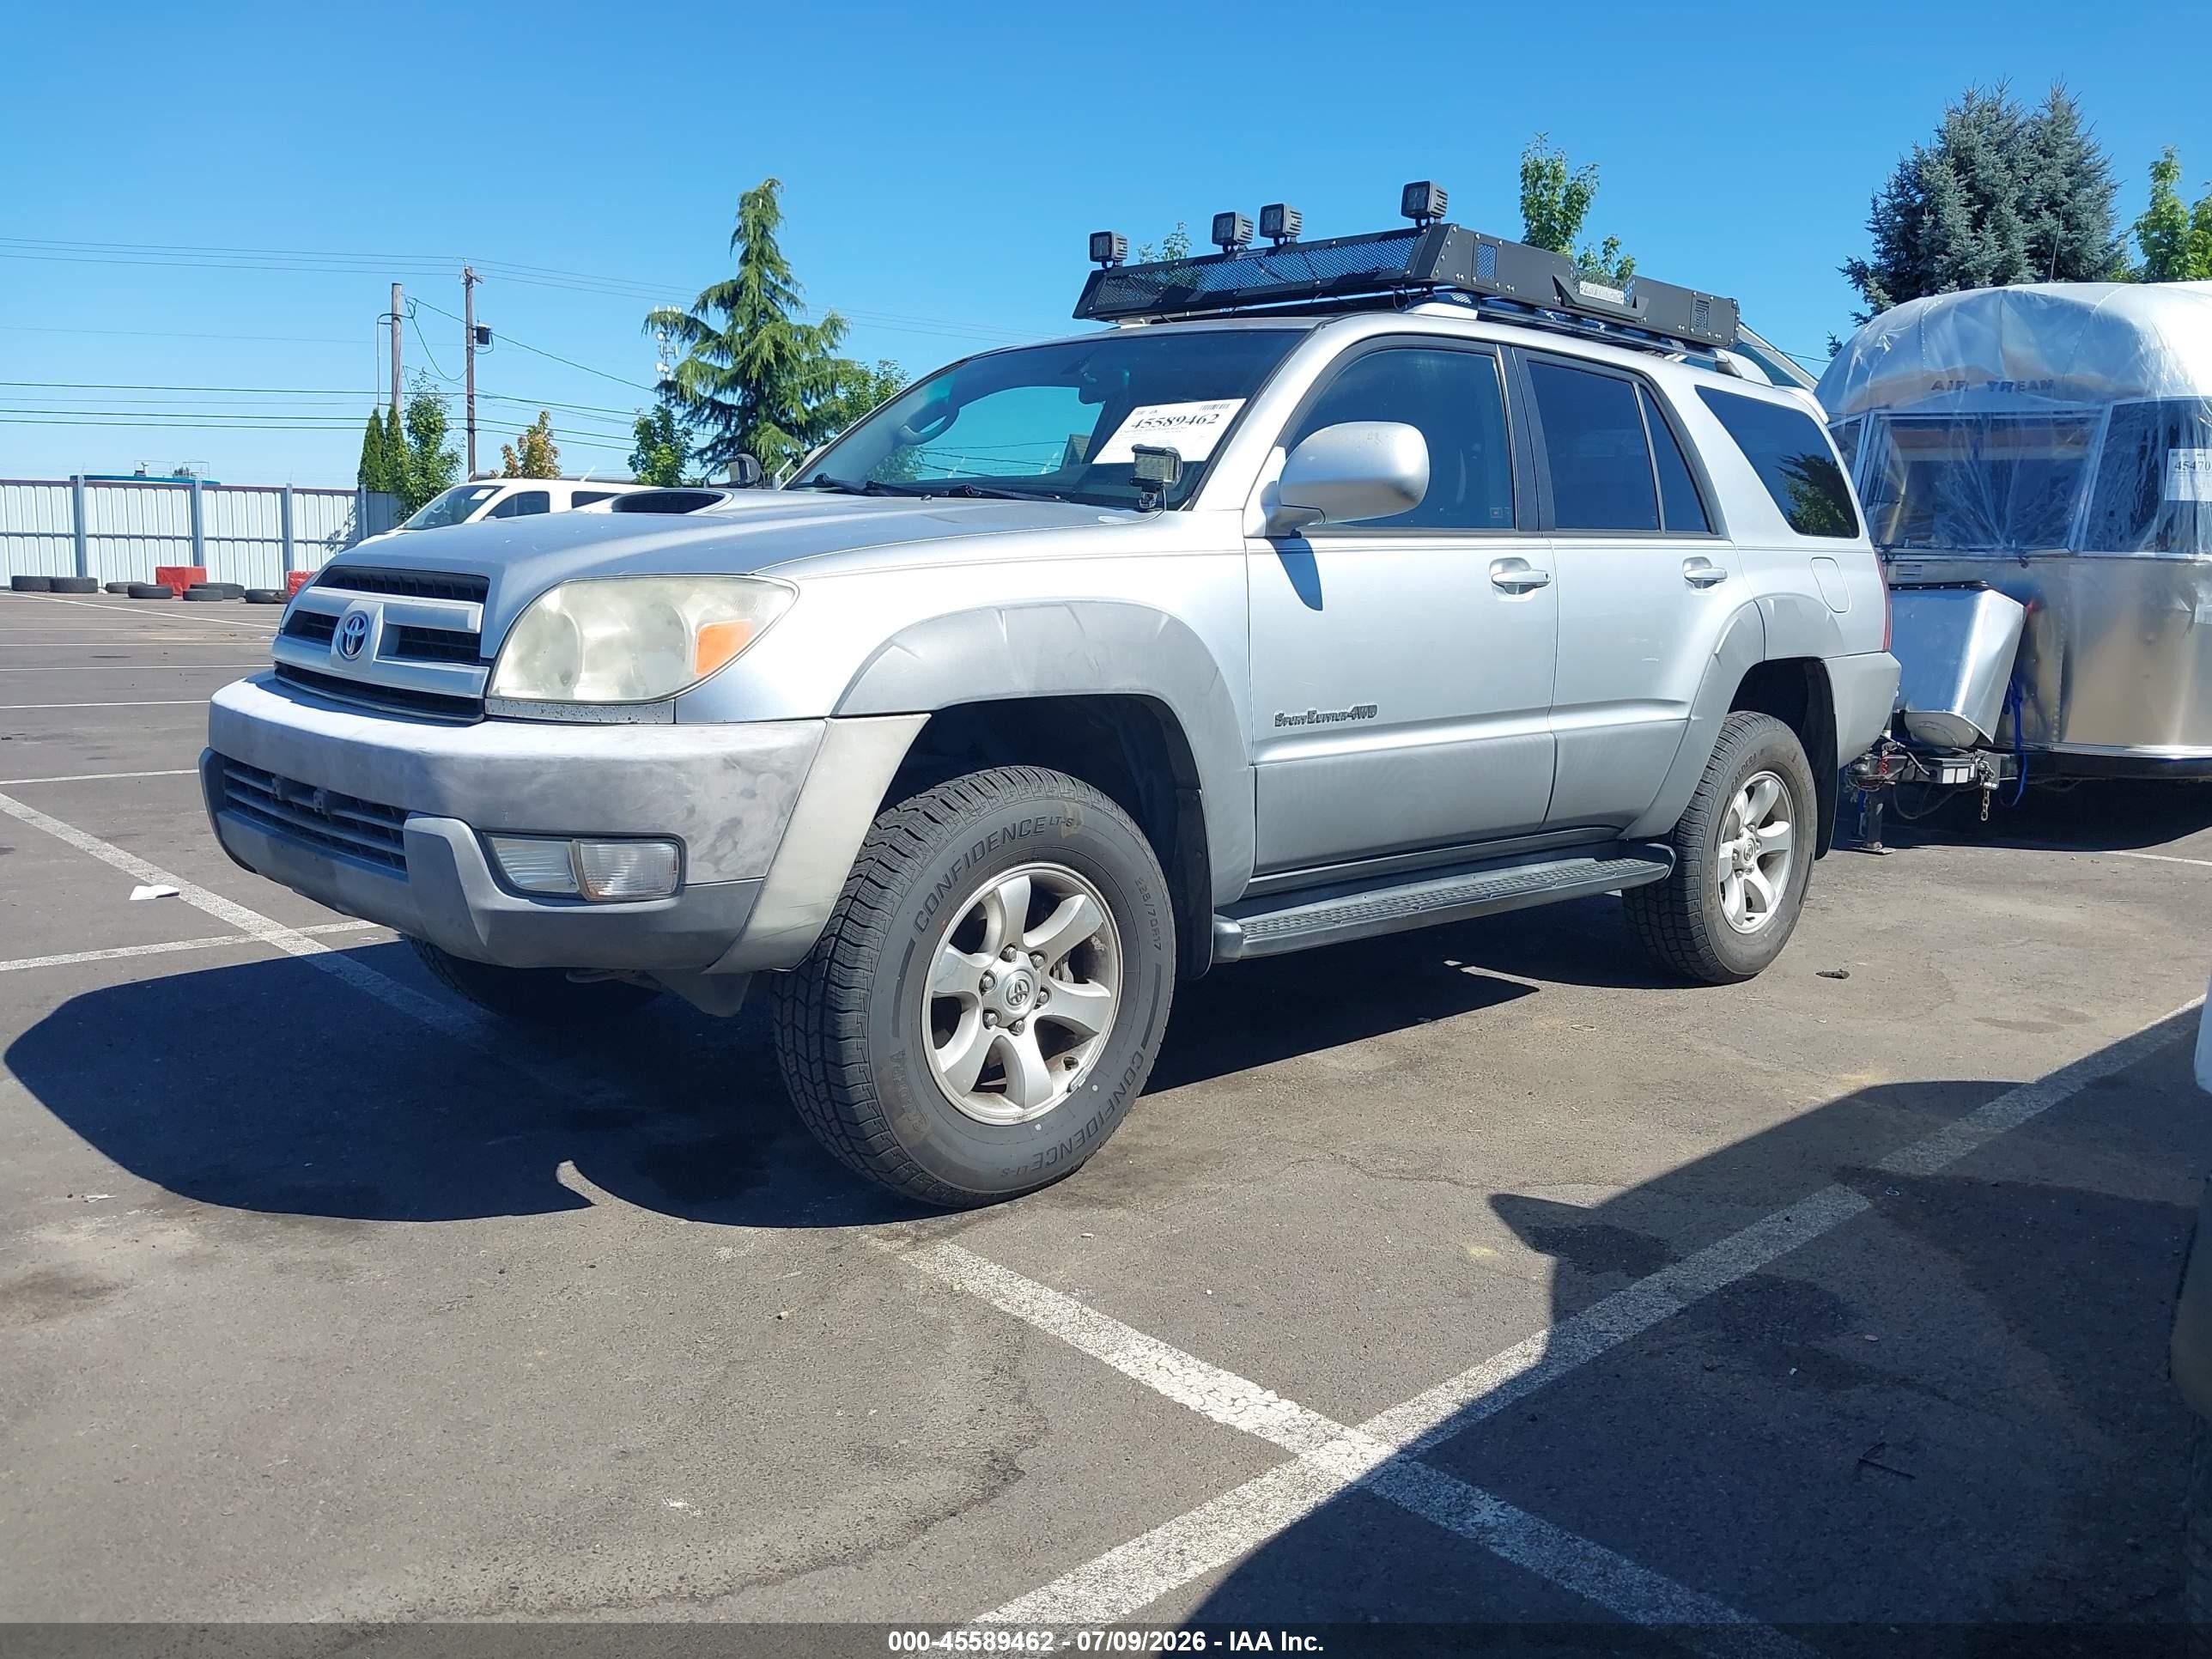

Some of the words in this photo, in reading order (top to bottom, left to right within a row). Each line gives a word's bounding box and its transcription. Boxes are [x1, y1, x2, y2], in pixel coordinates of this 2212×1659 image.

[1132, 414, 1219, 428] 45589462
[914, 817, 1046, 934] CONFIDENCE
[1049, 816, 1073, 828] LT-S
[1031, 1051, 1144, 1171] CONFIDENCE
